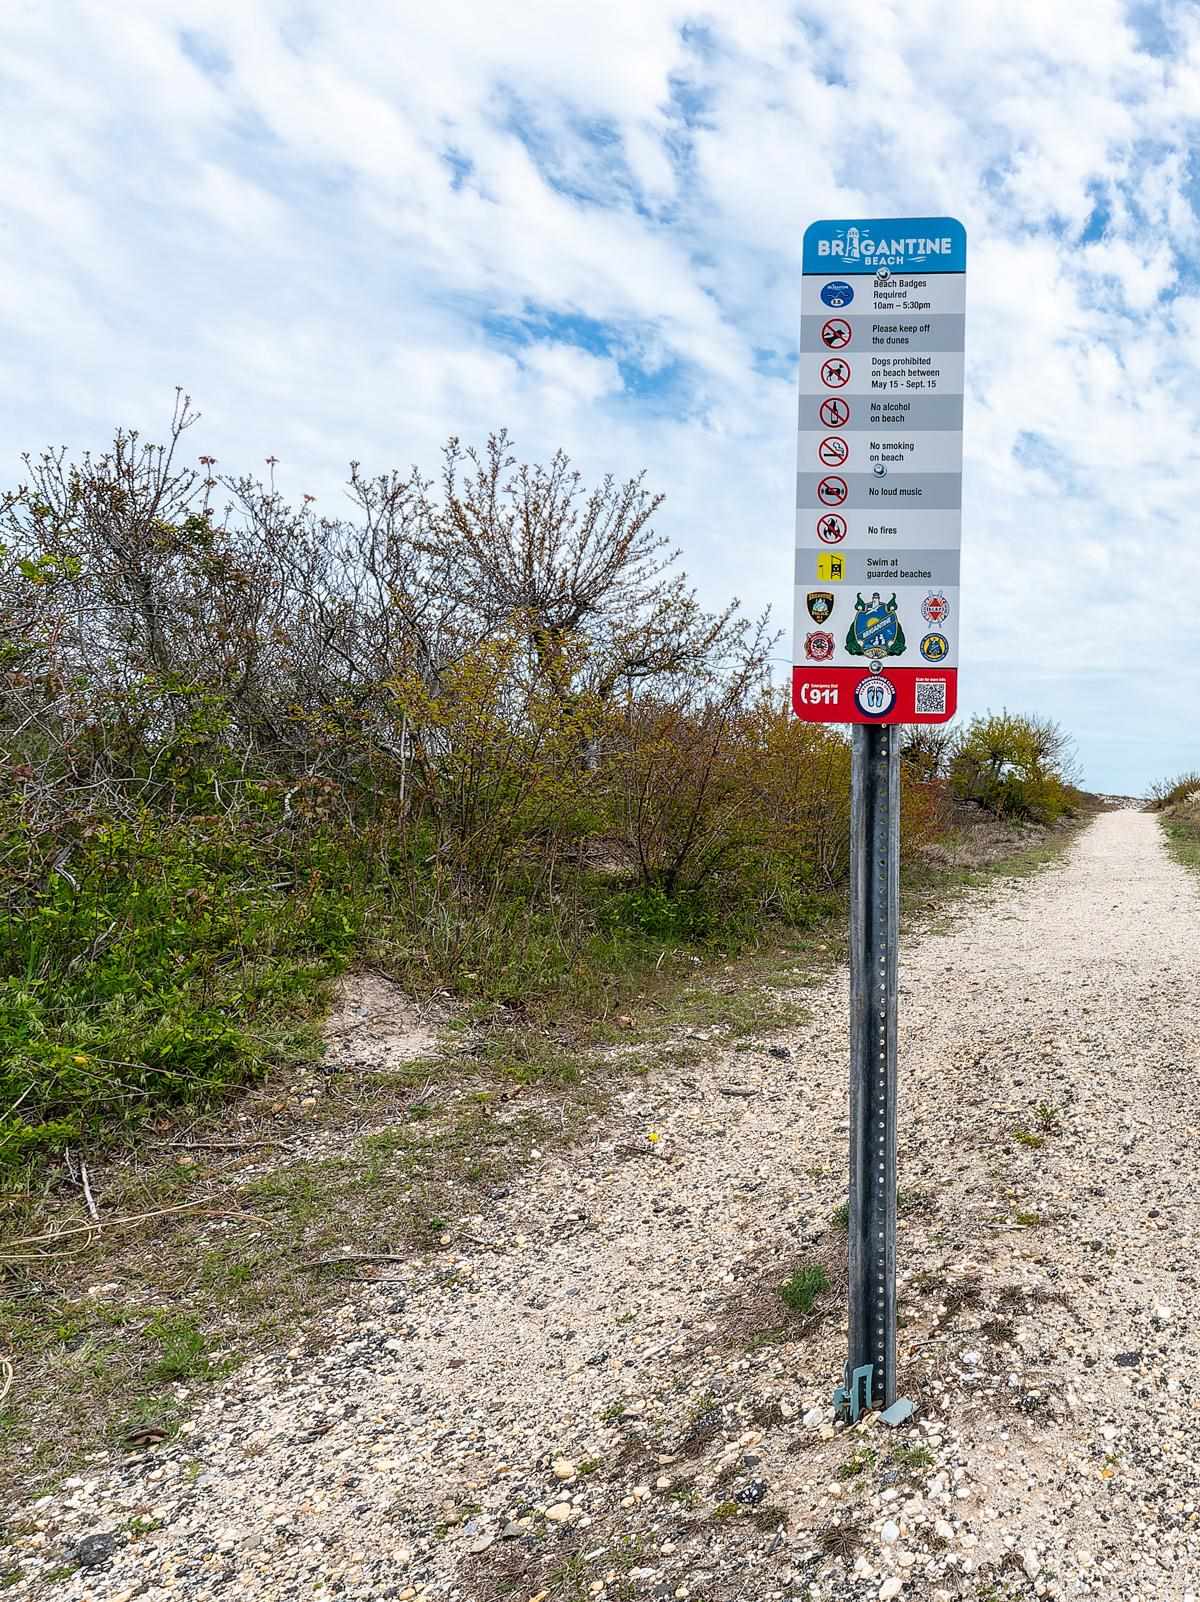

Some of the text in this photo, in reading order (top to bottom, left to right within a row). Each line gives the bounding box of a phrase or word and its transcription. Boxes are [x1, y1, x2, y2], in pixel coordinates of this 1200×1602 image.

[865, 256, 904, 265] BEACH
[873, 279, 927, 289] Beach Badges
[873, 290, 907, 300] Required
[873, 301, 894, 310] 10am
[903, 301, 931, 311] 5:30pm
[872, 324, 930, 335] Please keep off
[872, 336, 909, 344] the dunes
[871, 357, 931, 367] Dogs prohibited
[882, 368, 906, 377] beach
[907, 368, 940, 377] between
[871, 380, 888, 390] May
[889, 380, 898, 388] 15
[905, 380, 926, 390] Sept.
[928, 380, 936, 388] 15
[870, 402, 911, 411] No alcohol
[870, 414, 905, 423] on beach
[870, 441, 915, 452] No smoking
[881, 453, 904, 461] beach
[868, 487, 922, 496] No loud music
[868, 526, 897, 534] No fires
[867, 558, 889, 566] Swim
[866, 569, 932, 579] guarded beaches
[810, 689, 839, 705] 911
